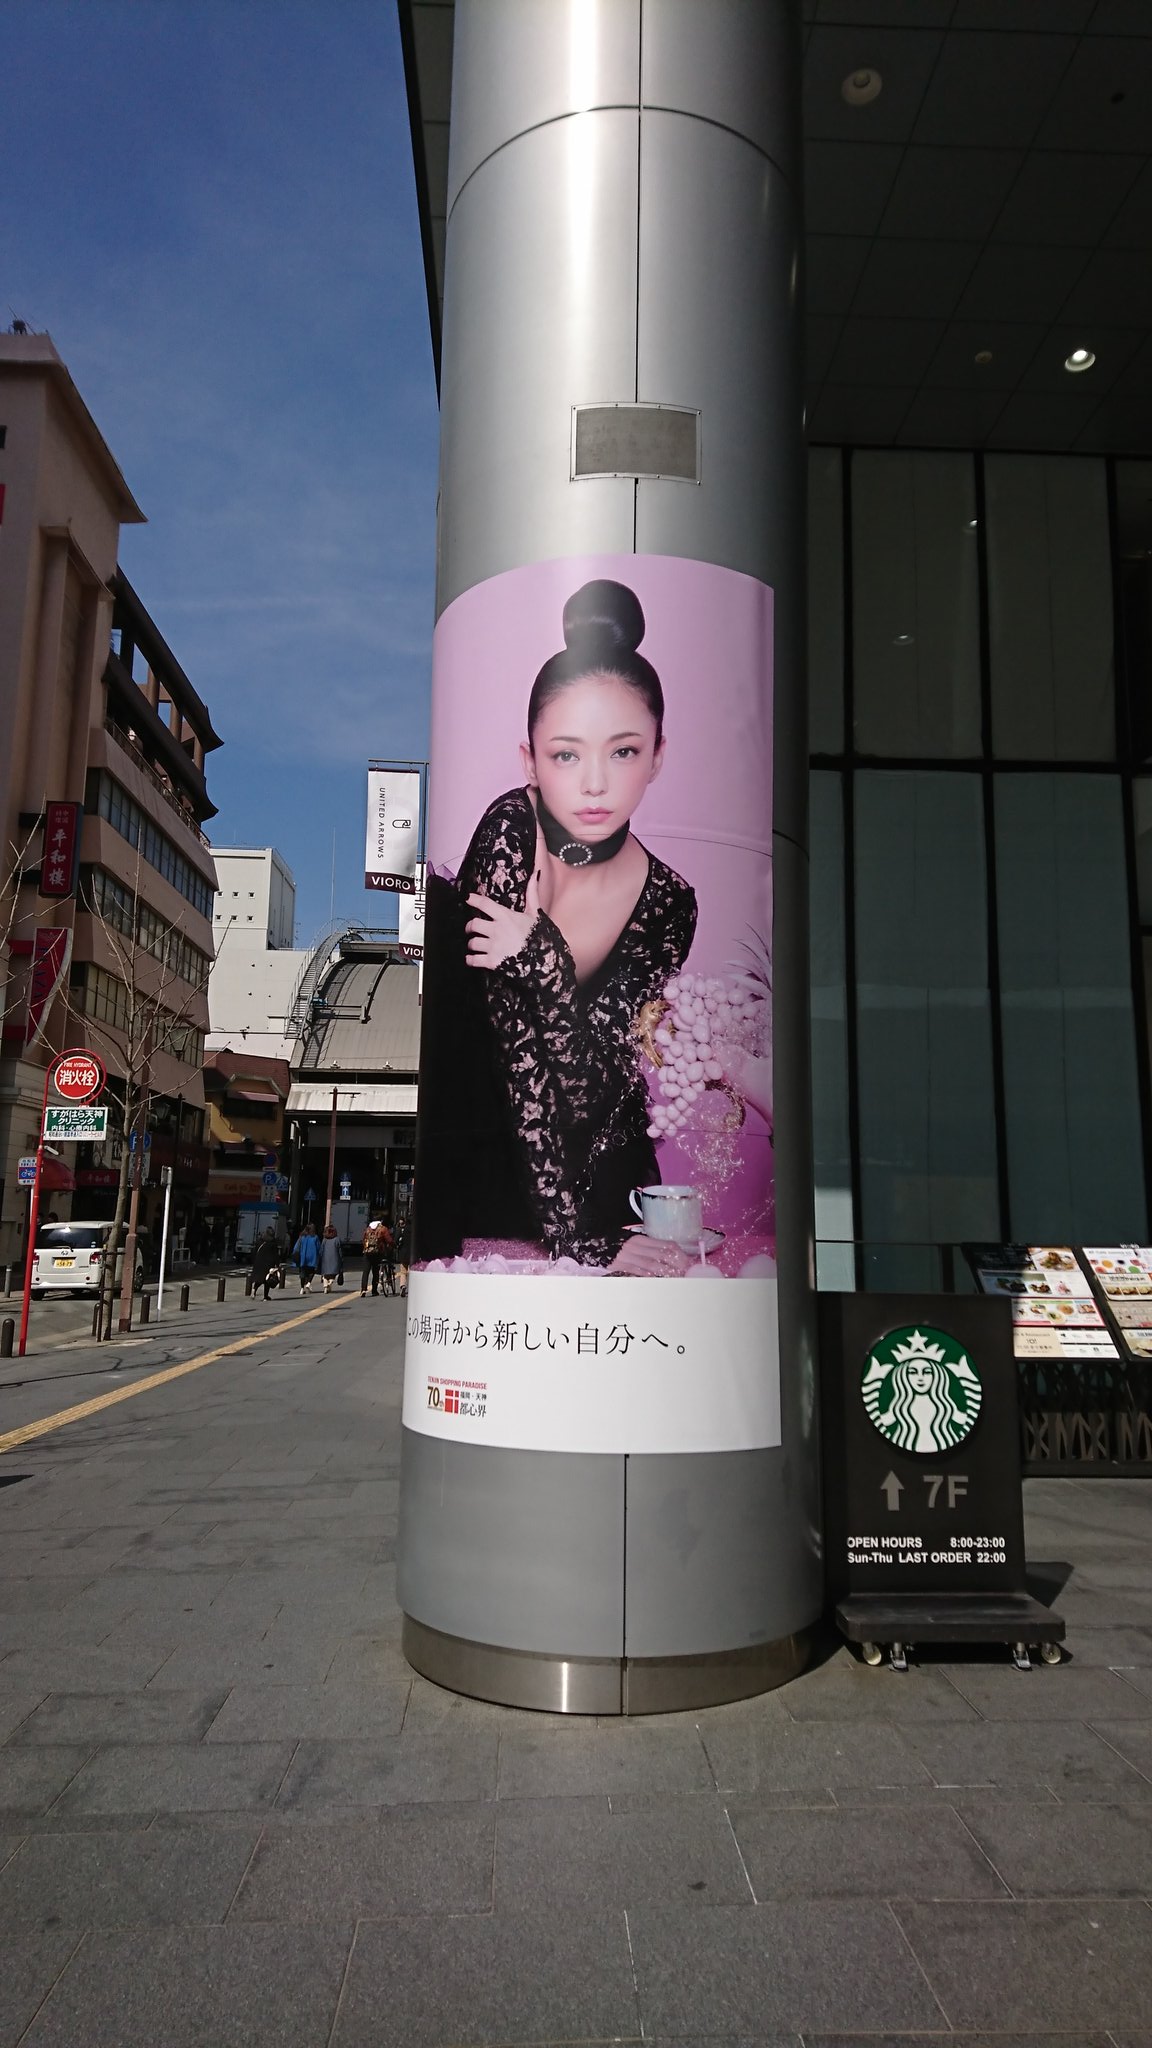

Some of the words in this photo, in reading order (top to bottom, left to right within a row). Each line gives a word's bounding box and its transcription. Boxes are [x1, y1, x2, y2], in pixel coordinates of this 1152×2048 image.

[378, 787, 386, 819] UNITED
[377, 821, 386, 859] ARROWS
[371, 876, 411, 891] VIORO
[403, 946, 423, 958] VIO
[59, 1069, 95, 1086] 消火栓
[51, 1110, 103, 1119] すがはら天神
[407, 1313, 686, 1355] この場所から新しい自分へ。
[440, 1378, 461, 1387] SHOPPING
[461, 1380, 488, 1390] PARADISE
[922, 1474, 969, 1509] 7F
[847, 1536, 879, 1548] OPEN
[881, 1536, 923, 1548] HOURS
[949, 1536, 1005, 1548] 8:00-23:00
[847, 1552, 893, 1563] Sun-Thu
[898, 1552, 928, 1563] LAST
[930, 1552, 972, 1563] ORDER
[976, 1552, 1006, 1563] 22:00
